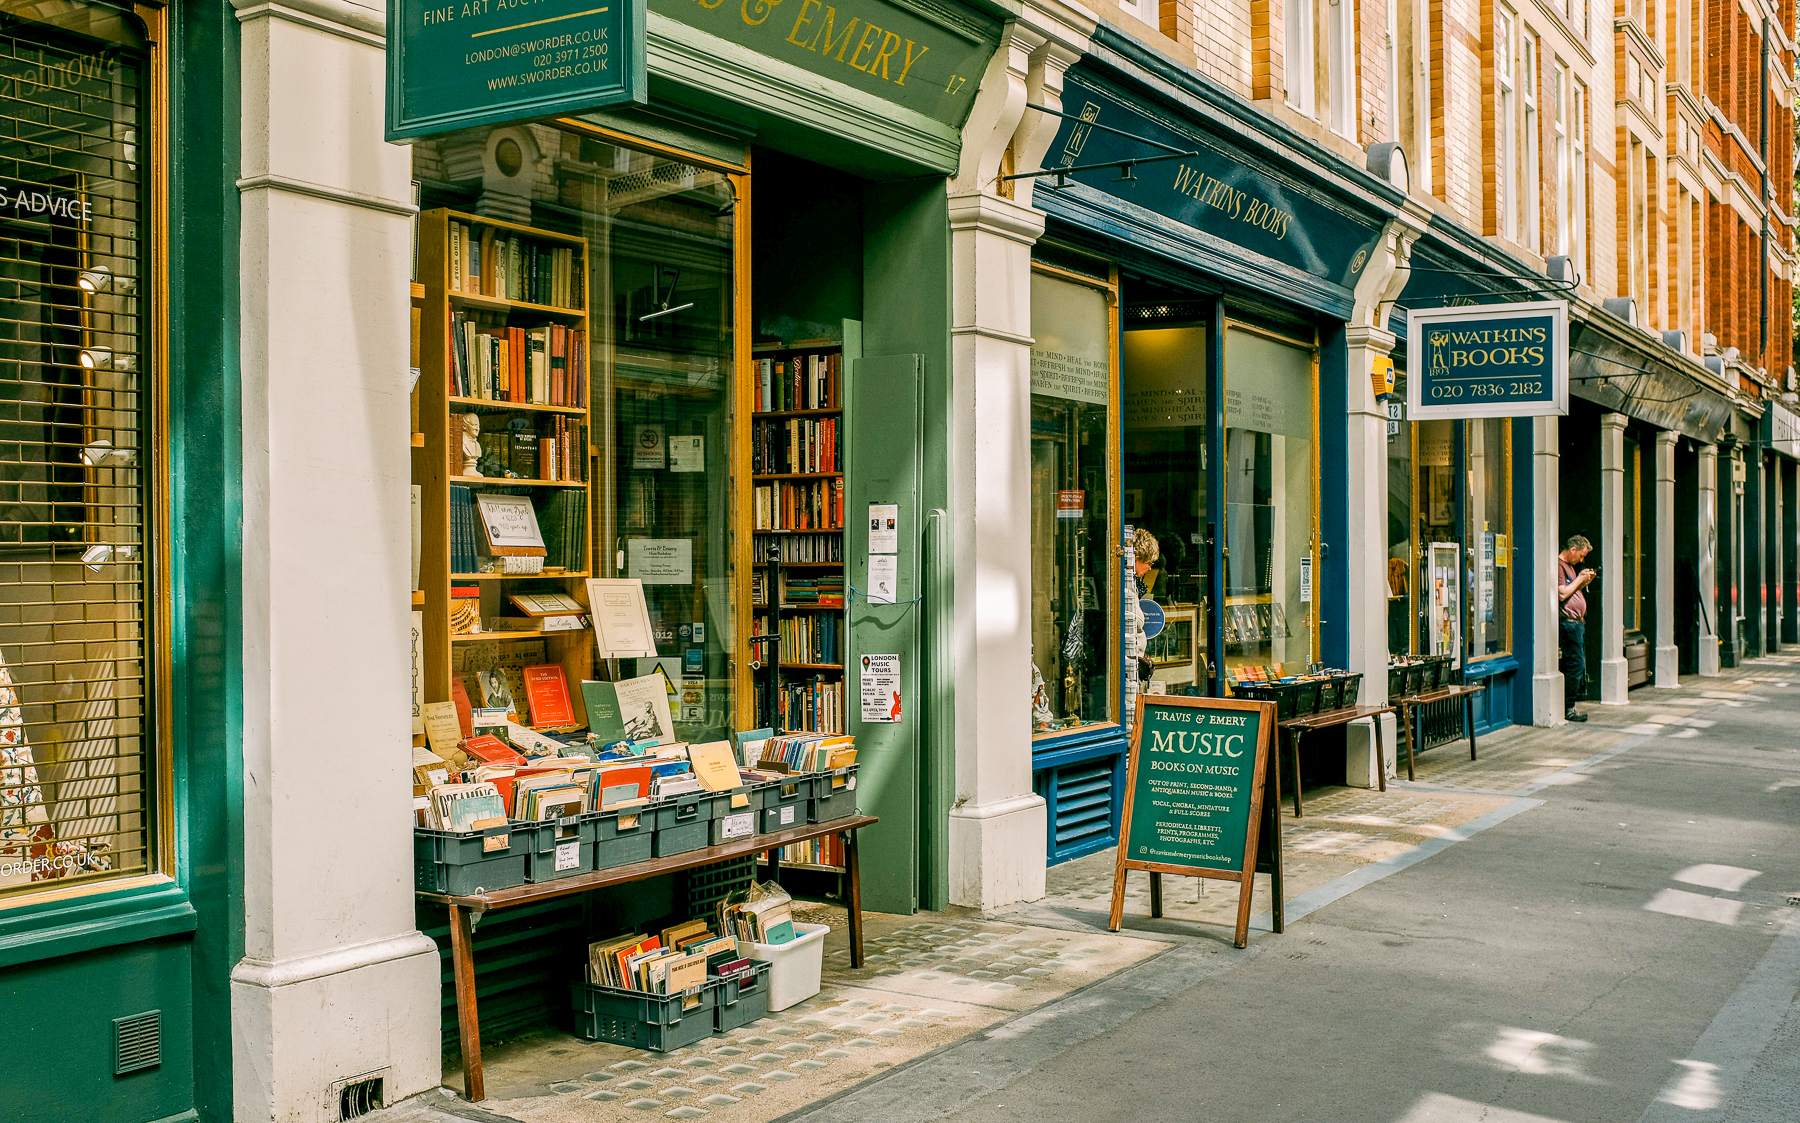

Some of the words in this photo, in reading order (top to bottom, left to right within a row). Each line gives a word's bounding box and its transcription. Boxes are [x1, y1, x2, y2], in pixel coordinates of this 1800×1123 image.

[424, 6, 454, 26] FINE
[461, 0, 489, 18] ART
[466, 28, 608, 65] LONDON@SWORDER.CO.UK
[786, 0, 929, 86] EMERY
[534, 54, 552, 67] 020
[555, 49, 579, 64] 3971
[582, 43, 608, 59] 2500
[488, 58, 608, 90] WWW.SWORDER.CO.UK
[945, 74, 966, 95] 17
[14, 190, 93, 222] ADVICE
[1172, 164, 1247, 220] WATKINS
[1242, 198, 1295, 241] BOOKS
[652, 263, 680, 306] 17
[1452, 327, 1546, 345] WATKINS
[1046, 351, 1063, 360] MIND
[1067, 356, 1082, 365] HEAL
[1452, 347, 1544, 368] BOOKS
[1076, 367, 1091, 376] MIND
[1429, 368, 1450, 376] 1893
[1432, 385, 1463, 398] 020
[1470, 384, 1504, 396] 7836
[1510, 382, 1542, 395] 2182
[1154, 710, 1191, 722] TRAVIS
[1196, 714, 1206, 723] &
[1209, 715, 1247, 727] EMERY
[1150, 730, 1244, 758] MUSIC
[1150, 760, 1185, 772] BOOKS
[1186, 764, 1203, 773] ON
[1205, 765, 1240, 776] MUSIC
[1150, 786, 1190, 796] ANTIQUARIAN
[1190, 782, 1233, 792] SECOND-HAND,
[1152, 800, 1171, 809] VOCAL,
[1172, 802, 1196, 810] CHORAL,
[1197, 804, 1230, 812] MINIATURE
[1156, 821, 1193, 830] PERIODICALS,
[1, 851, 96, 877] ORDER.CO.UK
